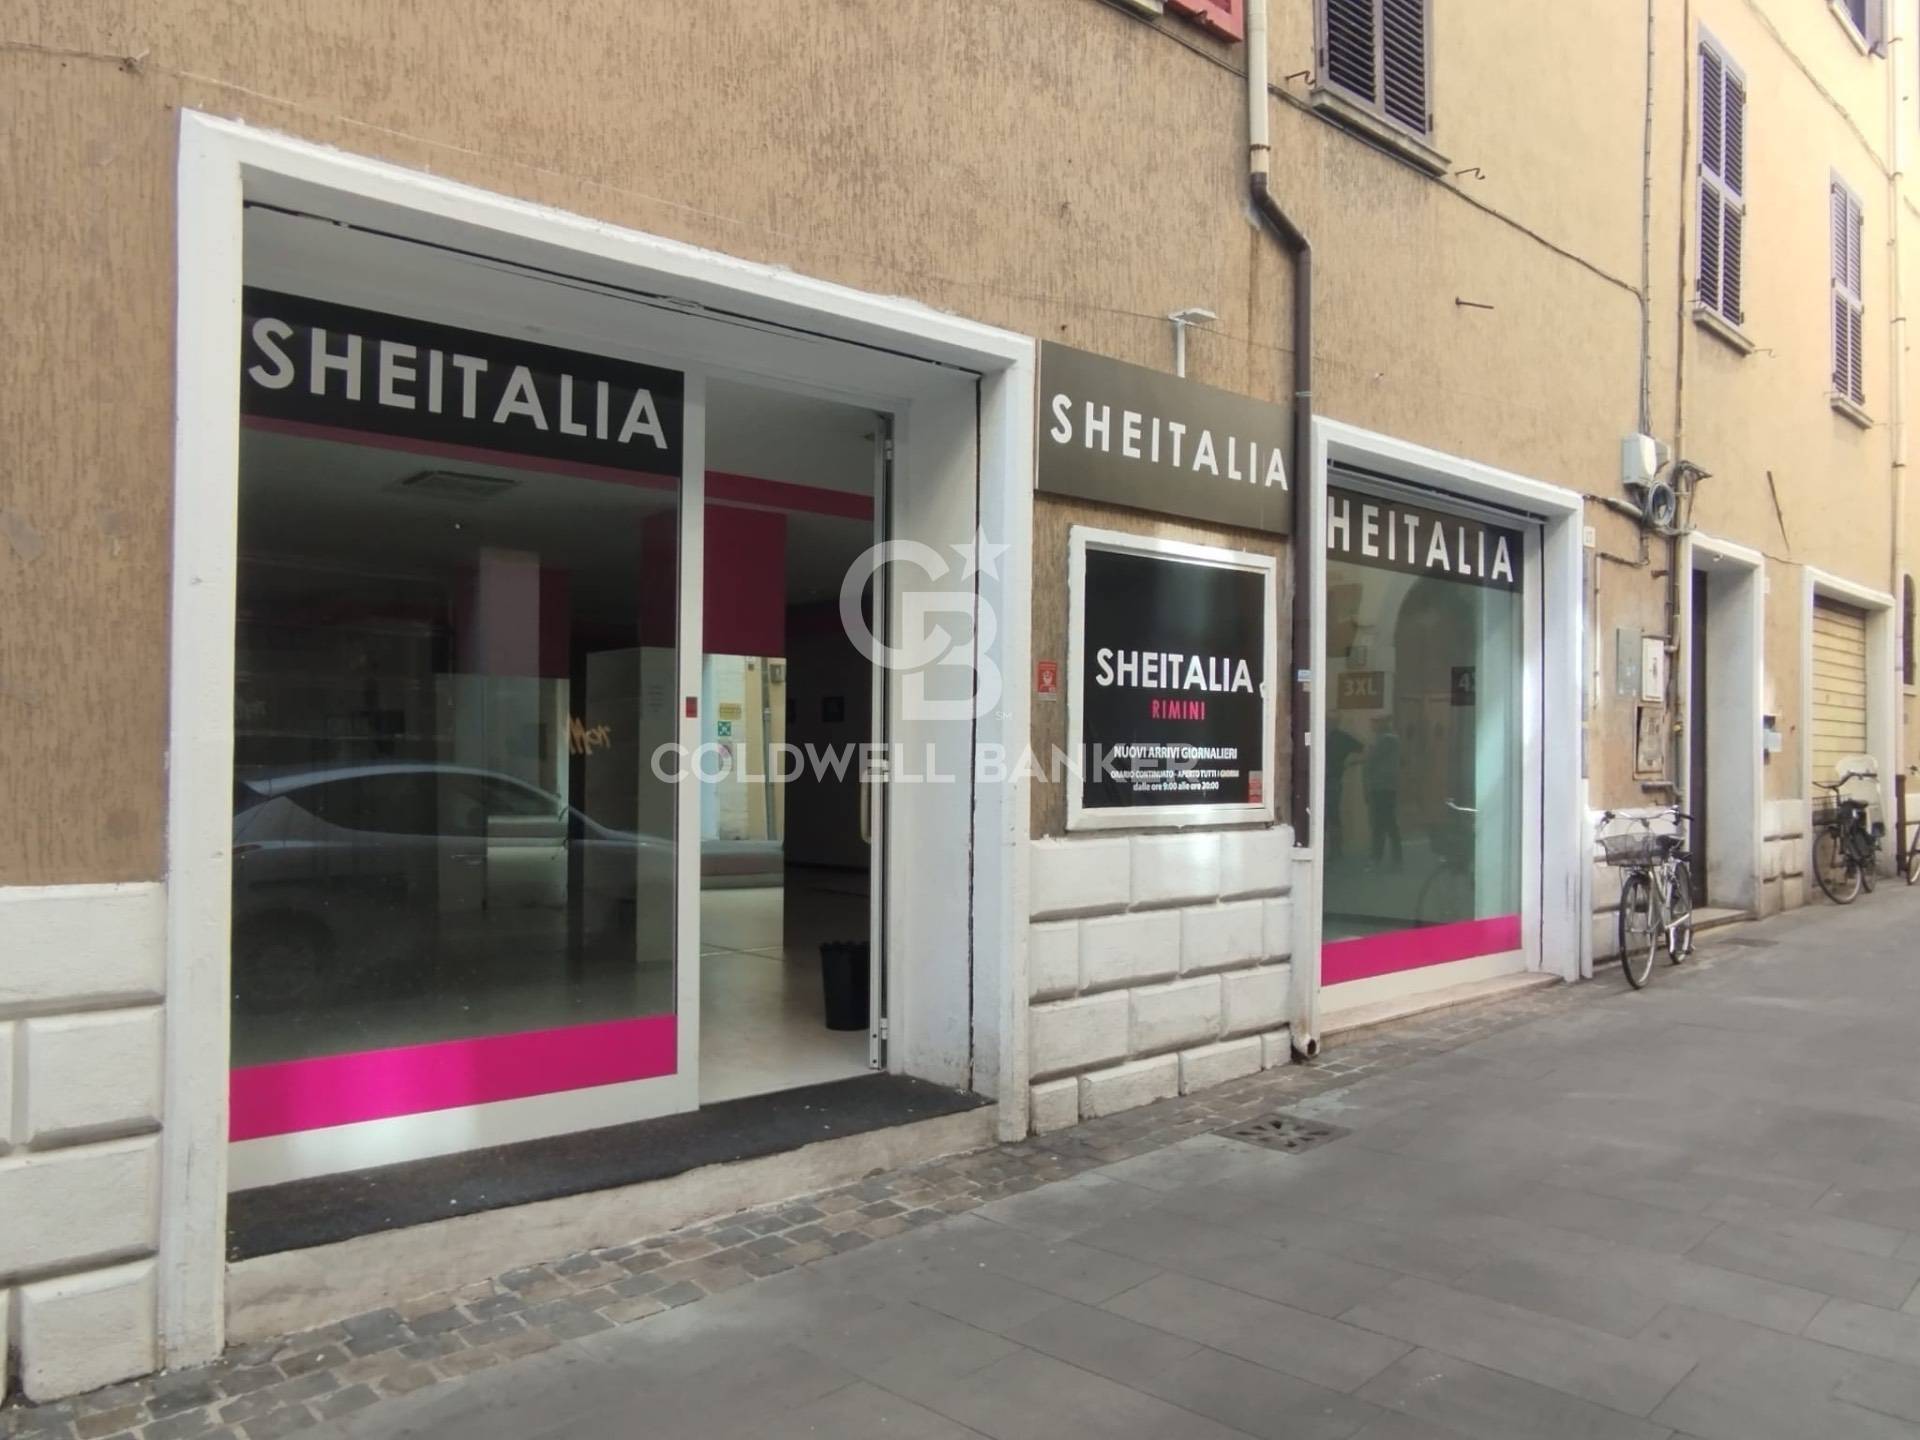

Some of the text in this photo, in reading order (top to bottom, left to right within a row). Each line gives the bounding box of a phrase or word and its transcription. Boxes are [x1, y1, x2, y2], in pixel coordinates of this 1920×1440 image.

[248, 317, 669, 450] SHEITALIA
[1050, 393, 1289, 491] SHEITALIA
[1096, 648, 1254, 693] SHEITALIA
[1152, 700, 1206, 720] RIMINI
[1113, 746, 1238, 759] NUOVI ARRIVI GIORNALIERI
[1200, 770, 1217, 778] TUTTI
[1151, 783, 1162, 791] ore
